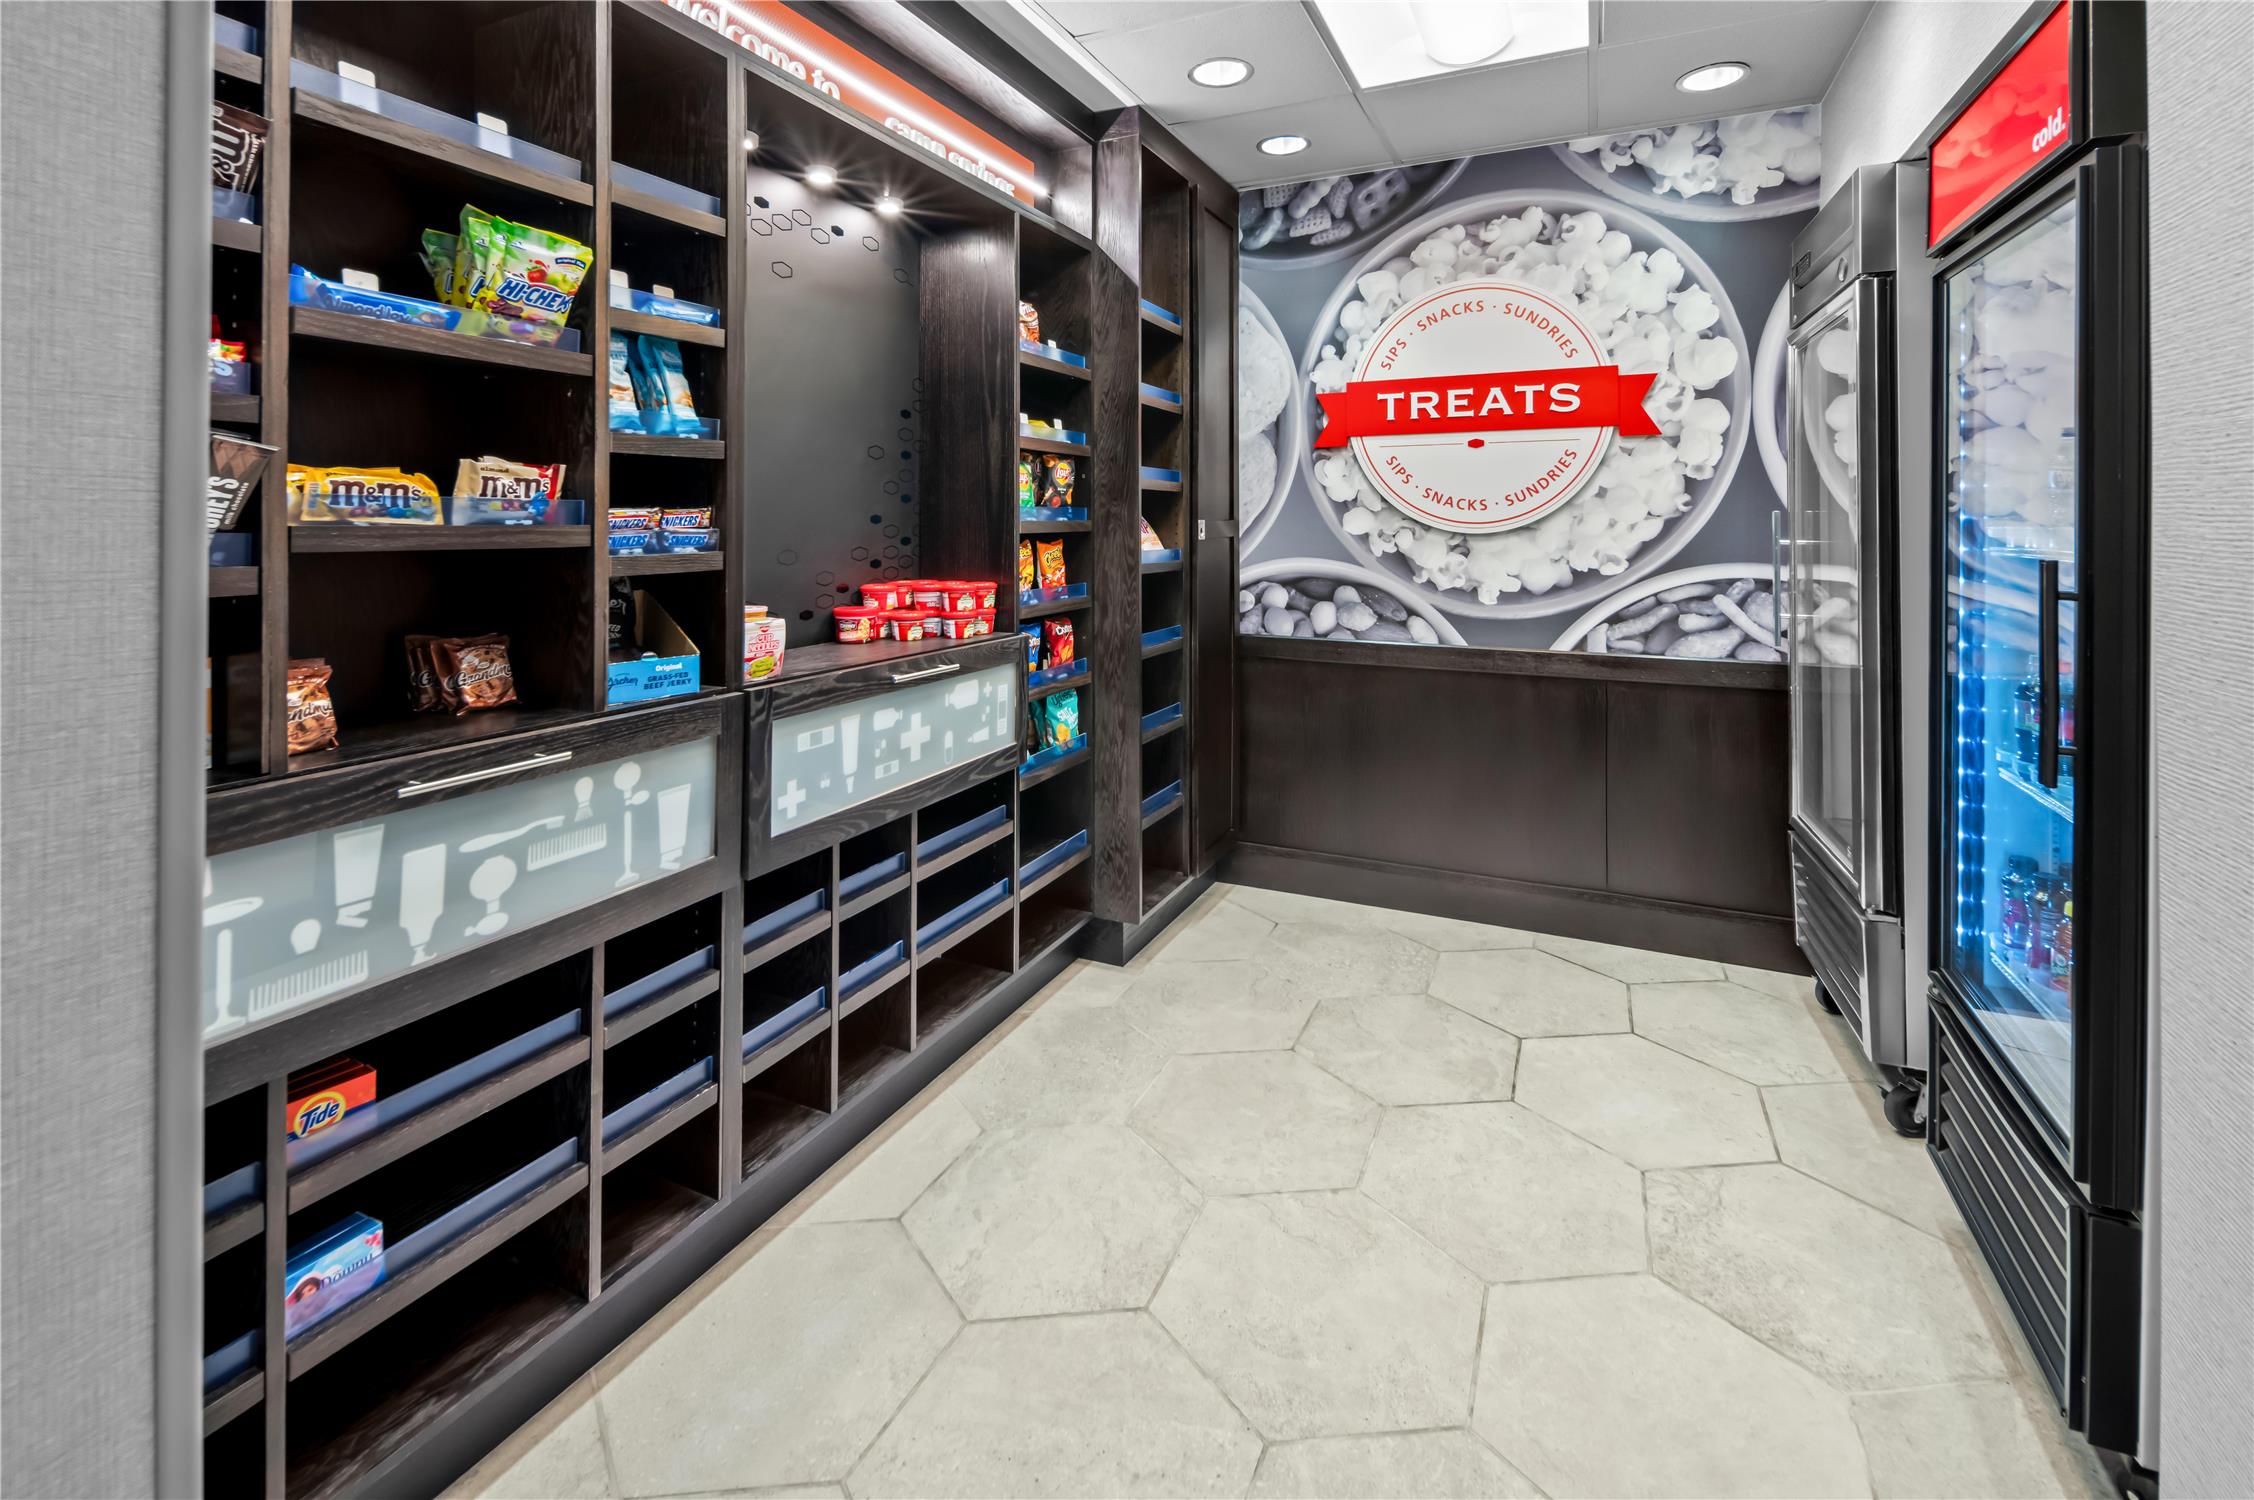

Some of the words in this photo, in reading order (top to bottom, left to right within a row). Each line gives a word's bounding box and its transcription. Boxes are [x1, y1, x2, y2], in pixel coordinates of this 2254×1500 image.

[812, 69, 841, 100] to
[2032, 106, 2066, 152] cold.
[1380, 338, 1407, 370] SIPS
[1417, 300, 1485, 331] SNACKS
[1503, 302, 1578, 359] SUNDRIES
[1377, 383, 1581, 421] TREATS
[1386, 455, 1414, 485] SIPS
[1422, 487, 1488, 511] SNACKS
[1504, 448, 1577, 507] SUNDRIES
[643, 680, 664, 690] BEEF
[666, 678, 692, 688] JERKY
[647, 671, 689, 683] GRASS-FED
[655, 662, 683, 671] Original
[299, 1100, 341, 1136] Tide
